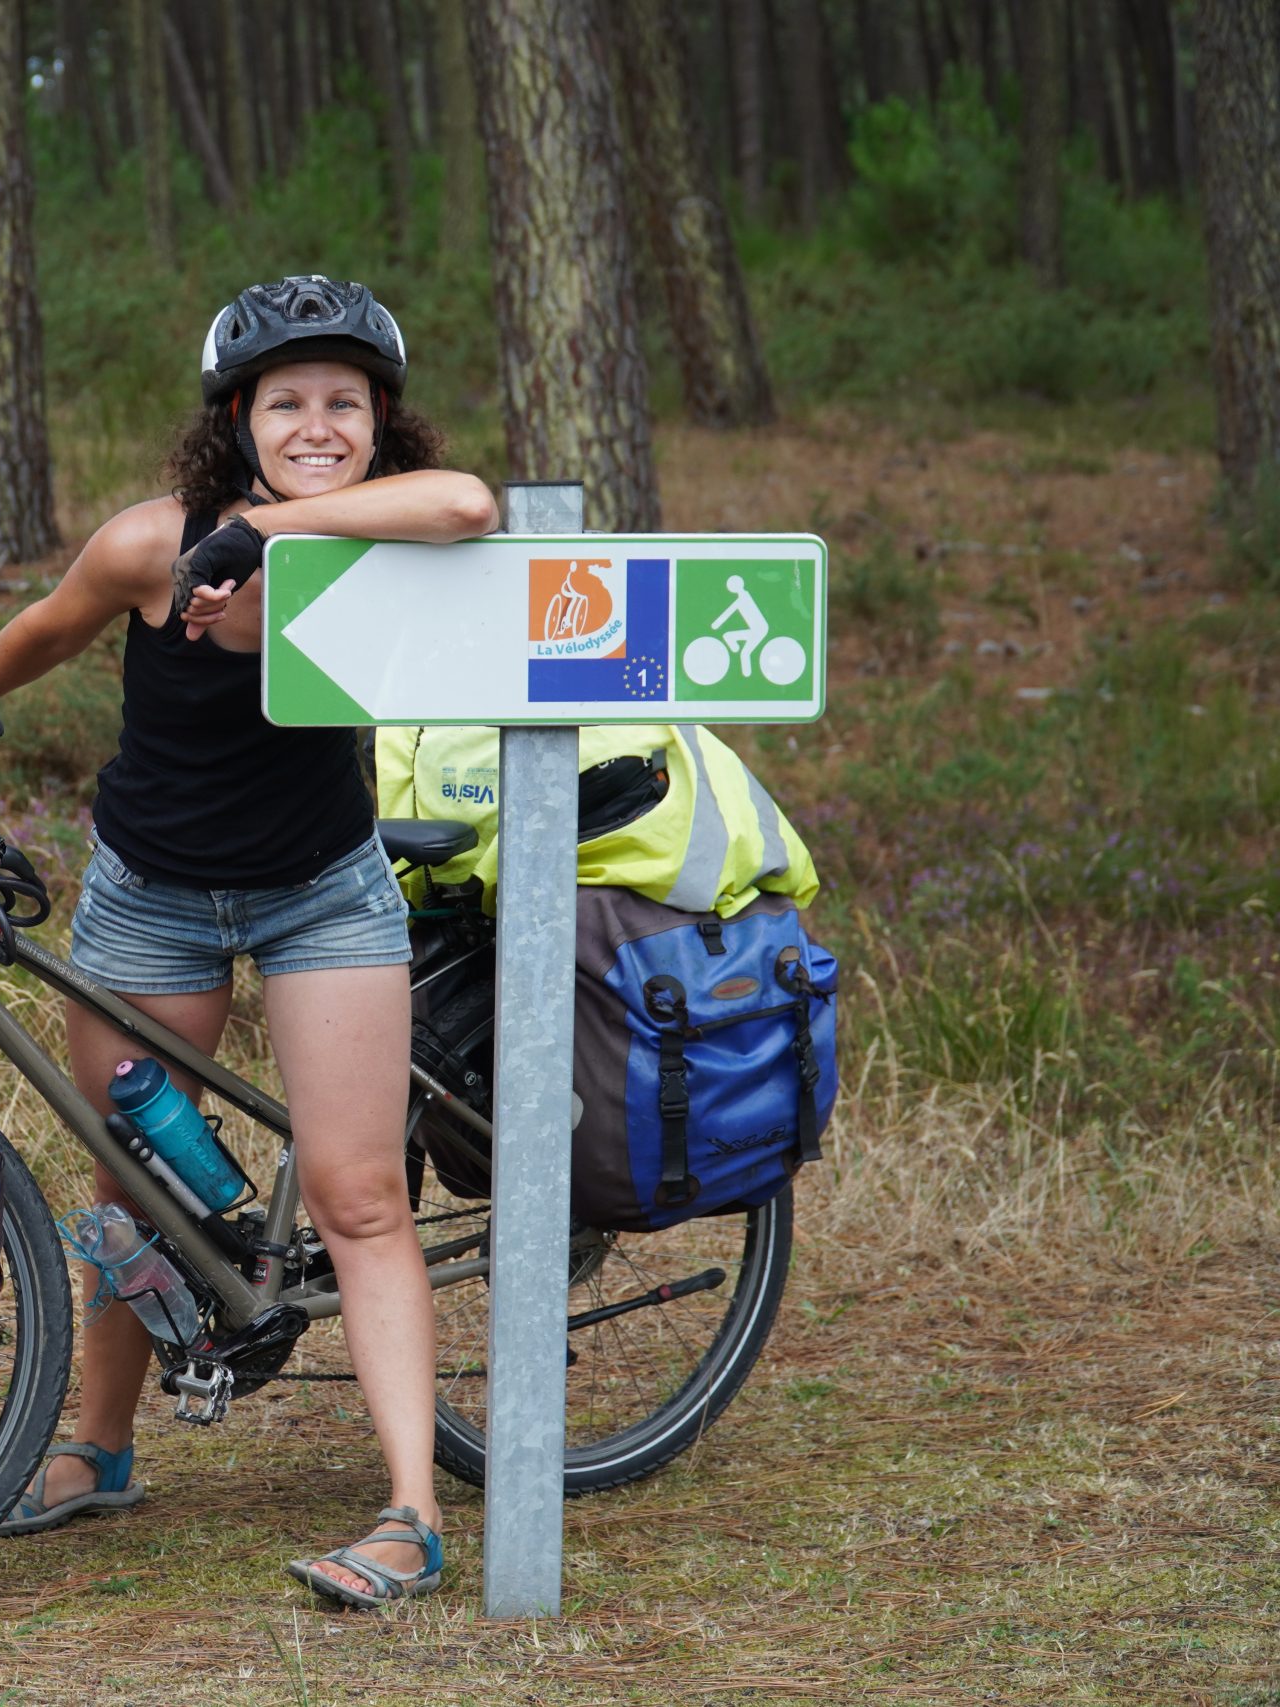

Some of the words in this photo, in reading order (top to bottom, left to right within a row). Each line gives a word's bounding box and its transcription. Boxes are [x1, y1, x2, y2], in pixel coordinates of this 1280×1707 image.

[537, 644, 553, 656] La
[555, 619, 623, 656] Vélodyssée
[637, 668, 648, 688] 1
[441, 783, 495, 804] Visite
